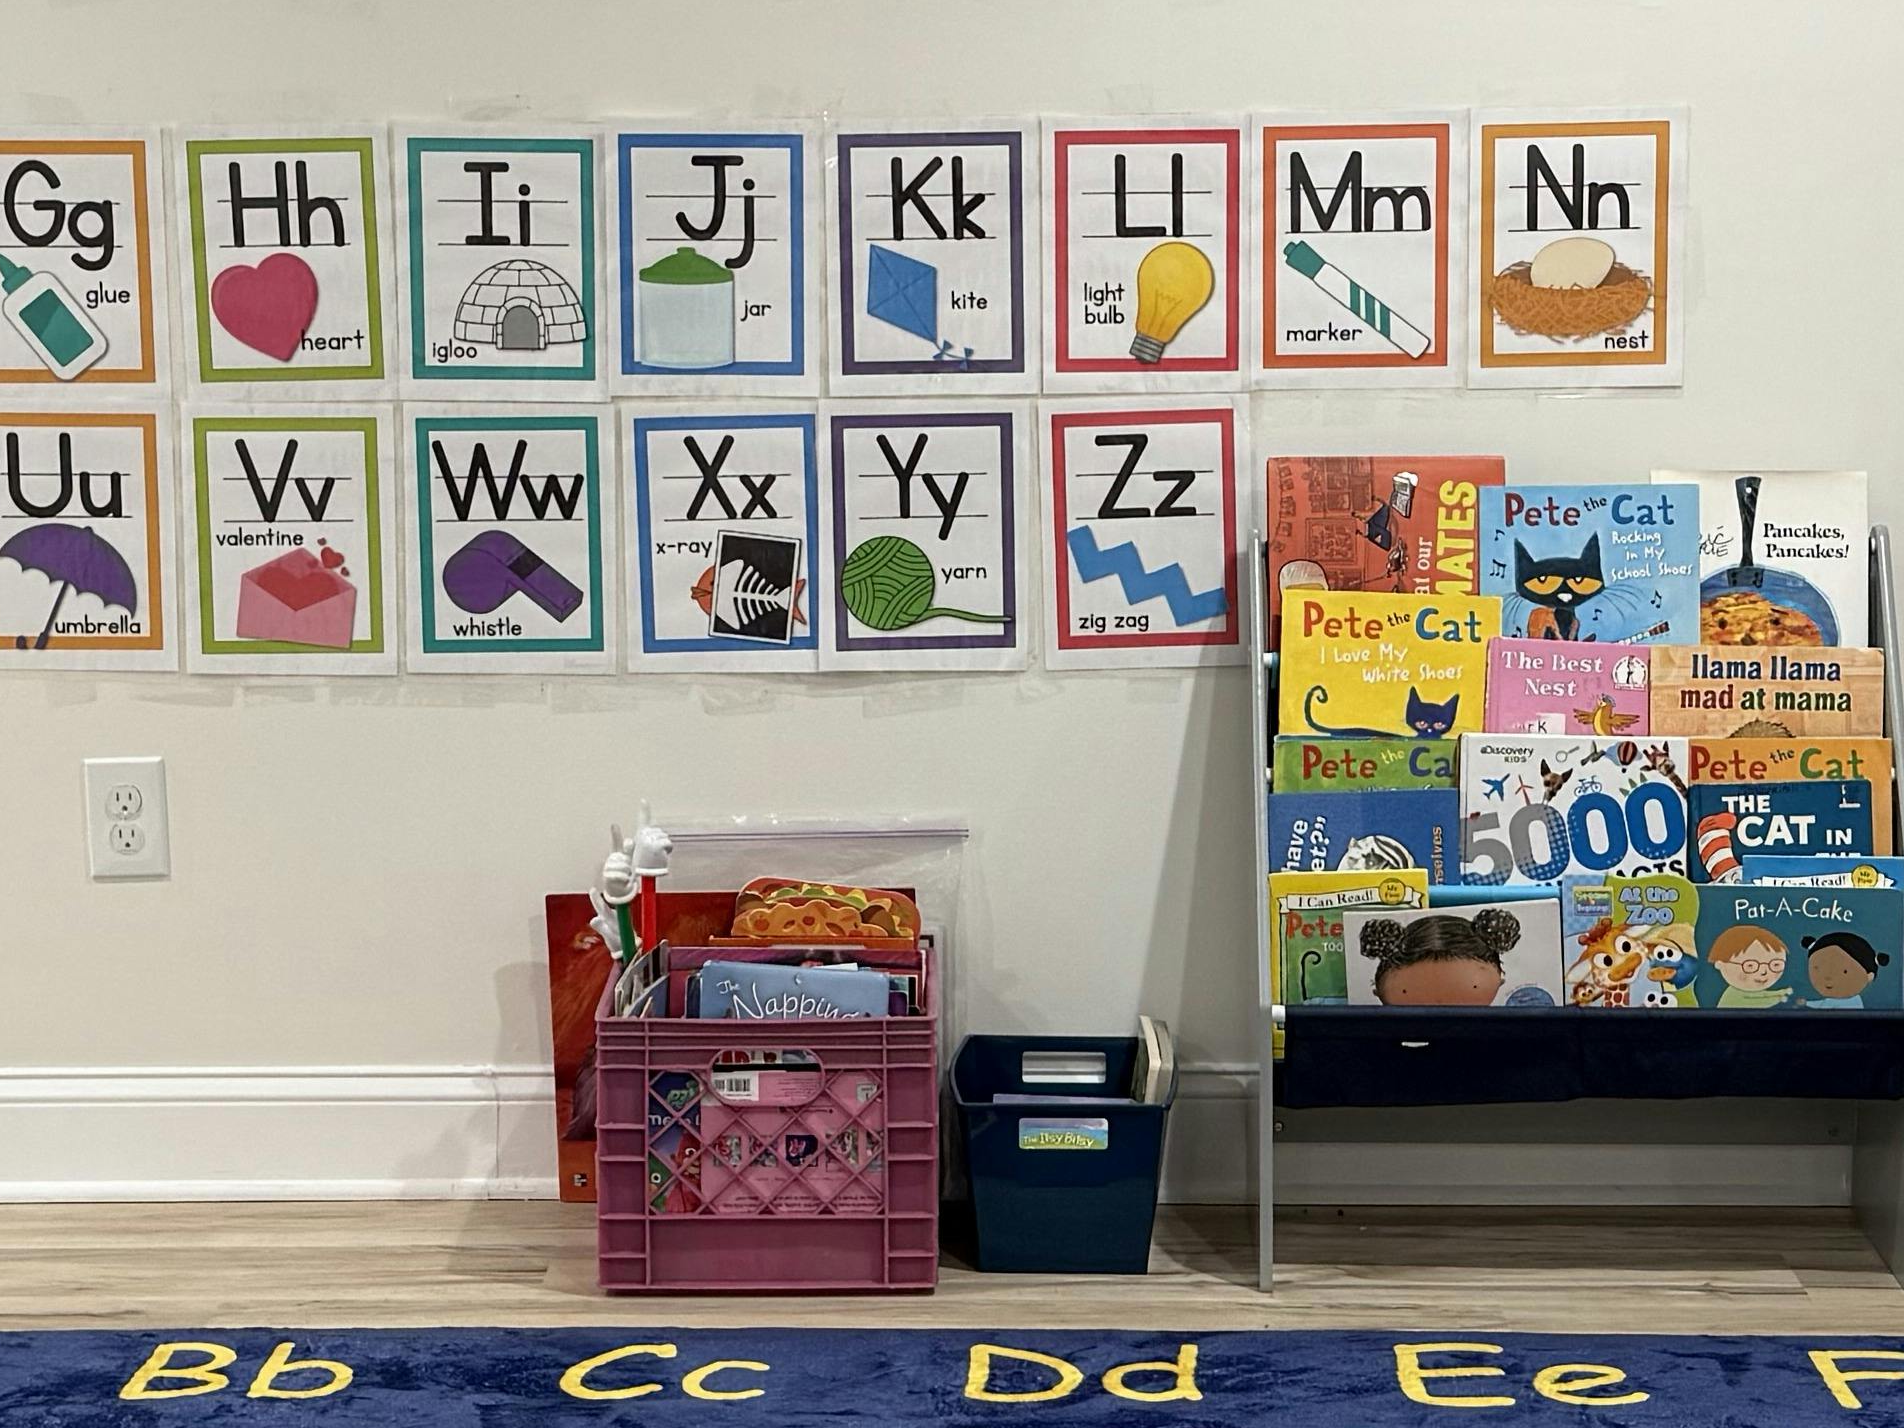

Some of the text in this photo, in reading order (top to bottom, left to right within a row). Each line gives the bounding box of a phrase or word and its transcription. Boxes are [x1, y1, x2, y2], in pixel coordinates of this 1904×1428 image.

[890, 155, 986, 242] Kk
[1114, 152, 1184, 239] Ll
[1289, 150, 1432, 234] Mm
[1526, 143, 1630, 232] Nn
[3, 159, 115, 272] Gg
[228, 160, 346, 249] Hh
[463, 161, 531, 247] Ii
[675, 154, 755, 270] Jj
[85, 280, 131, 310] glue
[951, 290, 988, 310] kite
[1084, 281, 1125, 307] light
[740, 299, 772, 322] jar
[1084, 304, 1125, 325] bulb
[301, 330, 364, 352] heart
[1286, 321, 1363, 342] marker
[1604, 329, 1649, 349] nest
[432, 338, 478, 364] igloo
[1505, 492, 1674, 527] Pete the Cat
[215, 526, 304, 547] valentine
[1612, 531, 1661, 545] Rocking
[1763, 523, 1845, 540] Pancakes,
[656, 541, 713, 559] x-ray
[1626, 546, 1664, 562] in My
[1766, 543, 1849, 559] Pancakes!
[940, 566, 987, 585] yarn
[1611, 564, 1691, 582] School Shoes
[54, 613, 141, 635] umbrella
[452, 616, 522, 637] whistle
[1078, 613, 1149, 634] zig zag
[1303, 601, 1482, 642] Pete the Cat
[1321, 643, 1408, 664] I Love My
[1501, 651, 1604, 673] The Best
[1362, 664, 1463, 684] White Shoes
[1692, 654, 1841, 681] llama llama
[1524, 678, 1577, 697] Nest
[1680, 684, 1851, 712] mad at mama
[1690, 745, 1864, 781] Pete the Cat
[1722, 794, 1771, 813] THE
[1460, 781, 1687, 886] 5000
[1737, 815, 1852, 847] CAT IN
[1625, 905, 1674, 926] Zoo
[1735, 898, 1853, 922] Pat-A-Cake
[119, 1343, 353, 1399] Bb
[559, 1344, 771, 1402] Cc
[964, 1343, 1204, 1404] Dd
[1393, 1343, 1650, 1407] Ee
